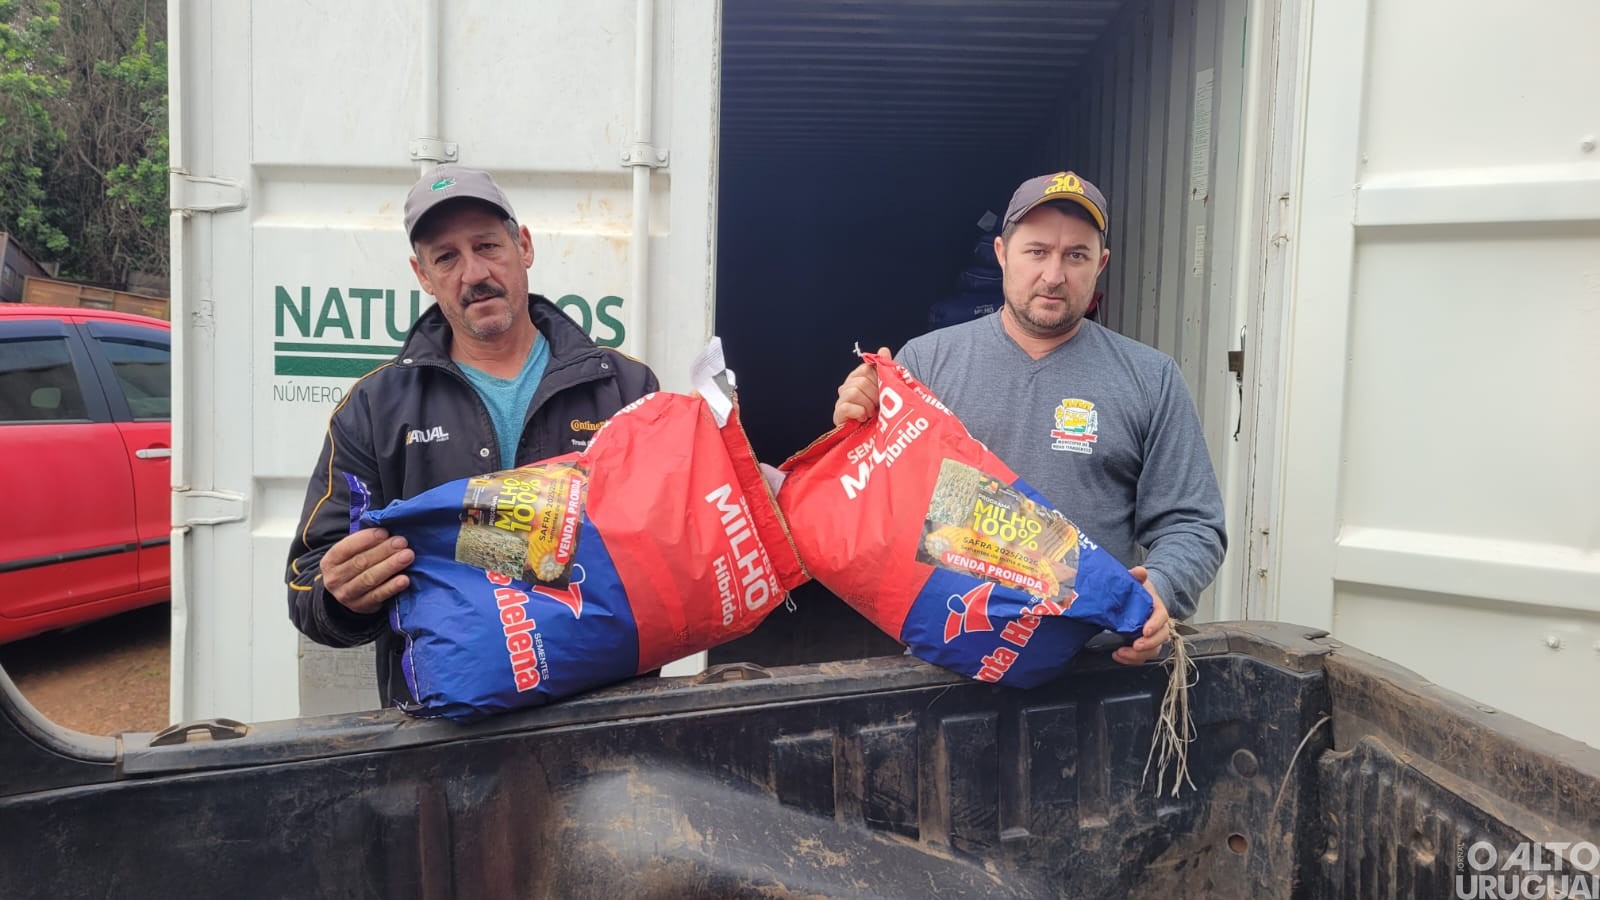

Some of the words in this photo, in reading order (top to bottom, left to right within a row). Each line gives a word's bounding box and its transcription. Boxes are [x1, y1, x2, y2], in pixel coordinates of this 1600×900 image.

[274, 284, 626, 349] NATUOS
[273, 381, 343, 403] NÚMERO
[494, 477, 521, 531] MILHO
[510, 479, 540, 532] 100%
[975, 498, 1042, 535] MILHO
[538, 510, 553, 542] SAFRA
[557, 514, 577, 558] VENDA
[963, 536, 992, 550] SAFRA
[973, 511, 1039, 551] 100%
[704, 483, 770, 611] MILHO
[946, 552, 986, 572] VENDA
[987, 564, 1044, 591] PROIBIDA
[534, 632, 550, 681] SEMENTES
